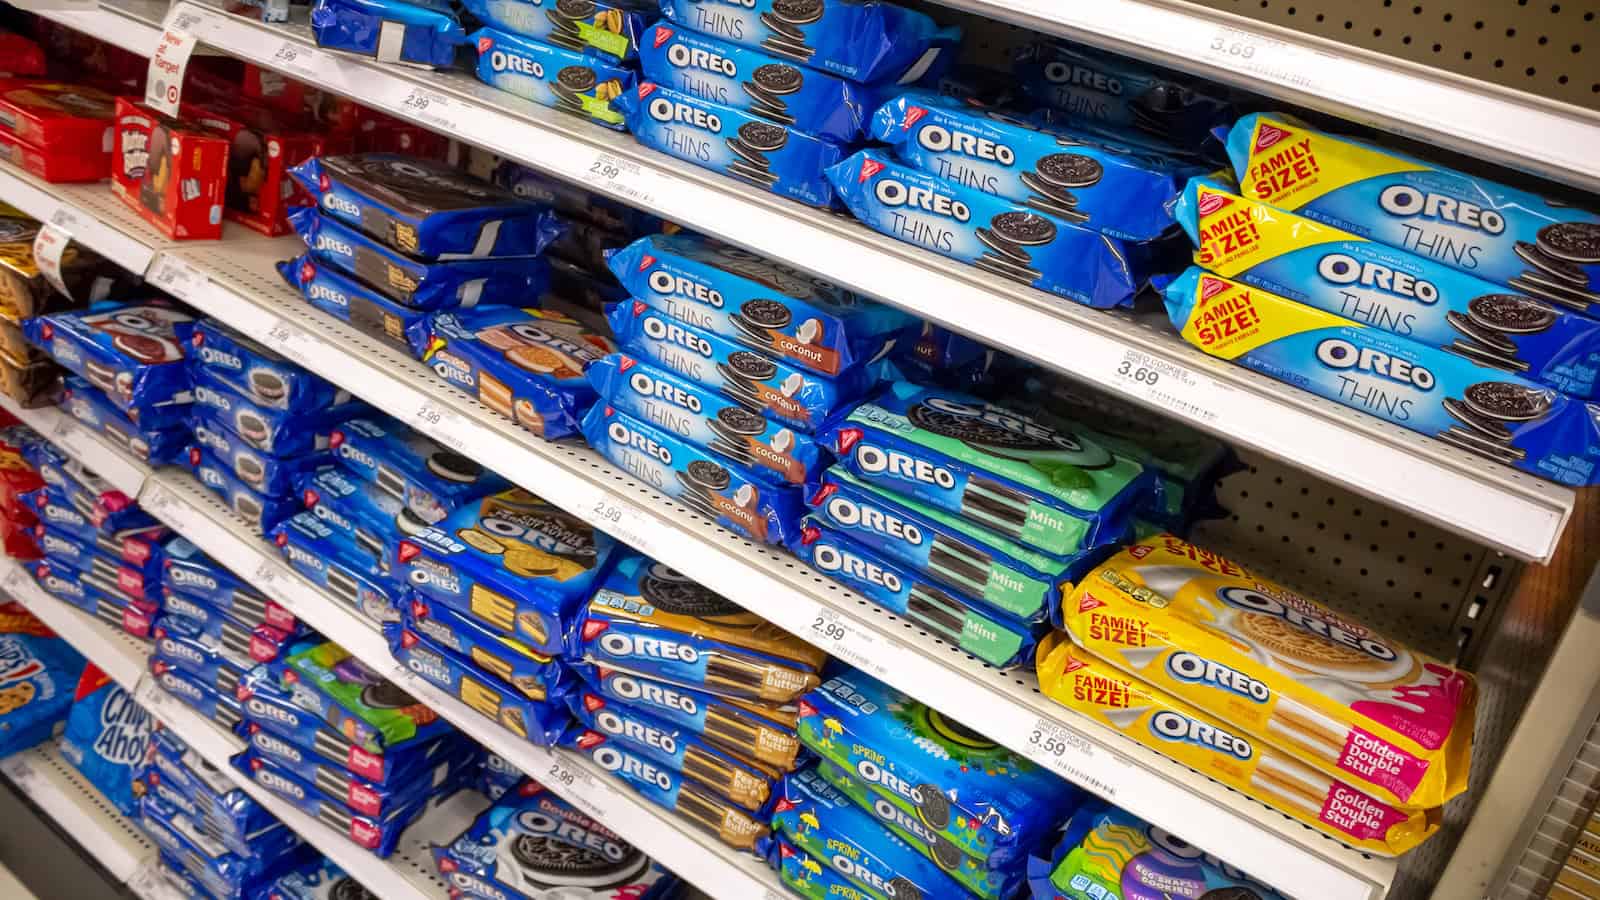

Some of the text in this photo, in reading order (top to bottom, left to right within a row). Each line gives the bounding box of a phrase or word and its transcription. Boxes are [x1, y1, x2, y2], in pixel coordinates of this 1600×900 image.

[696, 7, 744, 40] THINS
[491, 51, 545, 78] OREO
[668, 43, 737, 77] OREO
[1210, 38, 1256, 59] 3.69
[681, 73, 728, 105] THINS
[1044, 61, 1123, 96] OREO
[407, 95, 429, 109] 2.99
[650, 98, 721, 132] OREO
[662, 126, 711, 162] THINS
[919, 124, 1015, 166] OREO
[1250, 139, 1312, 181] FAMILY
[590, 162, 620, 180] 2.99
[936, 157, 999, 196] THINS
[1256, 156, 1319, 199] SIZE!
[324, 193, 360, 217] OREO
[876, 178, 971, 222] OREO
[1380, 185, 1505, 235] OREO
[889, 212, 954, 252] THINS
[1200, 206, 1252, 244] AMILY
[316, 234, 353, 257] OREO
[1199, 222, 1260, 264] SIZE!
[1401, 223, 1482, 270] THINS
[310, 284, 348, 306] OREO
[649, 270, 724, 309] OREO
[1319, 254, 1439, 304] OREO
[664, 298, 713, 331] THINS
[1194, 290, 1252, 331] FAMILY
[1199, 307, 1261, 346] SIZE!
[1339, 290, 1417, 336] THINS
[643, 316, 712, 357] OREO
[780, 340, 822, 363] coconut
[202, 347, 242, 369] OREO
[433, 361, 475, 387] OREO
[656, 343, 703, 381] THINS
[1117, 361, 1160, 385] 3.69
[1317, 339, 1435, 390] OREO
[631, 372, 702, 414] OREO
[1337, 375, 1413, 421] THINS
[416, 407, 441, 424] 2.99
[643, 400, 692, 437] THINS
[924, 398, 1081, 451] OREO
[340, 443, 375, 468] OREO
[609, 422, 672, 465] OREO
[619, 449, 663, 487] THINS
[857, 444, 956, 488] OREO
[314, 505, 351, 530] OREO
[593, 501, 622, 523] 2.99
[827, 497, 923, 544] OREO
[1030, 509, 1065, 532] Mint
[170, 567, 216, 590] OREO
[410, 569, 460, 593] OREO
[813, 544, 902, 592] OREO
[991, 570, 1025, 593] Mint
[811, 617, 845, 640] 2.99
[966, 619, 998, 642] Mint
[1090, 625, 1147, 647] SIZE!
[1091, 613, 1149, 631] FAMILY
[1226, 588, 1396, 660] OREO
[600, 632, 698, 663] OREO
[408, 659, 450, 685] OREO
[1074, 674, 1132, 695] FAMILY
[1168, 651, 1270, 702] OREO
[612, 675, 697, 715] OREO
[1073, 685, 1130, 709] SIZE!
[250, 699, 298, 726] OREO
[257, 735, 301, 761] OREO
[597, 712, 676, 754] OREO
[1029, 730, 1066, 757] 3.59
[1152, 711, 1252, 760] OREO
[1354, 733, 1404, 766] Golden
[592, 747, 672, 791] OREO
[852, 743, 886, 767] SPRING
[1343, 755, 1376, 777] Stuf
[1349, 743, 1400, 775] Double
[258, 771, 304, 800] OREO
[549, 764, 574, 785] 2.99
[858, 760, 923, 804] OREO
[540, 799, 589, 828] Double
[1326, 810, 1357, 830] Stuf
[1330, 798, 1380, 830] Double
[1334, 788, 1384, 820] Golden
[520, 811, 623, 864] OREO
[826, 838, 860, 860] SPRING
[832, 855, 896, 897] OREO
